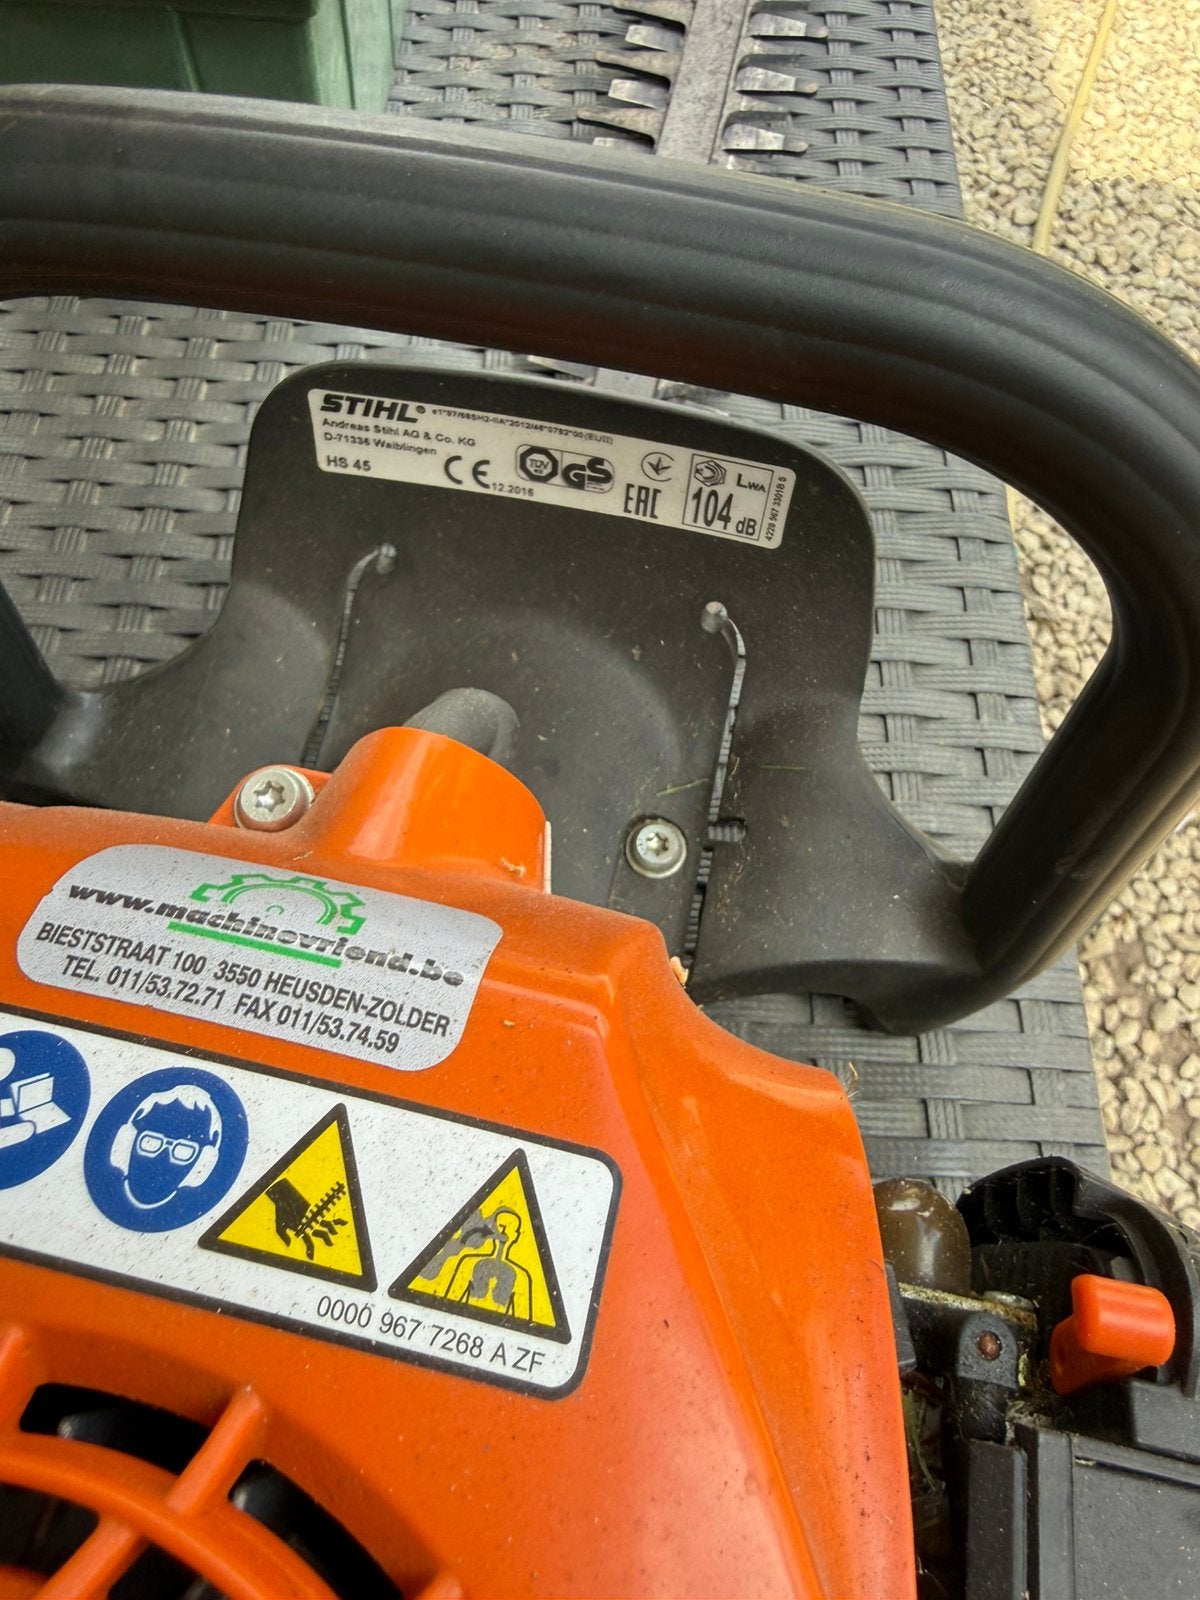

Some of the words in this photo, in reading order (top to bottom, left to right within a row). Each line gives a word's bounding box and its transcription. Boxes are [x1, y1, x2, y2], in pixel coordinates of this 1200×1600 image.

[320, 393, 418, 423] STIHL
[322, 418, 370, 433] Andreas
[373, 424, 399, 437] Stihl
[403, 429, 420, 439] AG
[423, 432, 432, 440] &
[435, 433, 455, 444] Co.
[457, 436, 476, 447] KG
[324, 432, 371, 446] D-71336
[373, 438, 438, 456] Waiblingen
[326, 455, 349, 469] HS
[352, 459, 371, 472] 45
[692, 486, 733, 530] 104
[735, 516, 757, 536] dB
[35, 922, 172, 965] BIESTSTRAAT
[174, 950, 207, 974] 100
[214, 960, 260, 988] 3550
[263, 972, 451, 1037] HEUSDEN-ZOLDER
[61, 955, 102, 983] TEL.
[106, 968, 225, 1010] 011/53.72.71
[233, 993, 277, 1020] FAX
[277, 1005, 400, 1053] 011/53.74.59
[316, 1295, 373, 1328] 0000
[379, 1312, 423, 1340] 967
[429, 1324, 484, 1358] 7268
[489, 1343, 507, 1366] A
[512, 1347, 546, 1373] ZF
